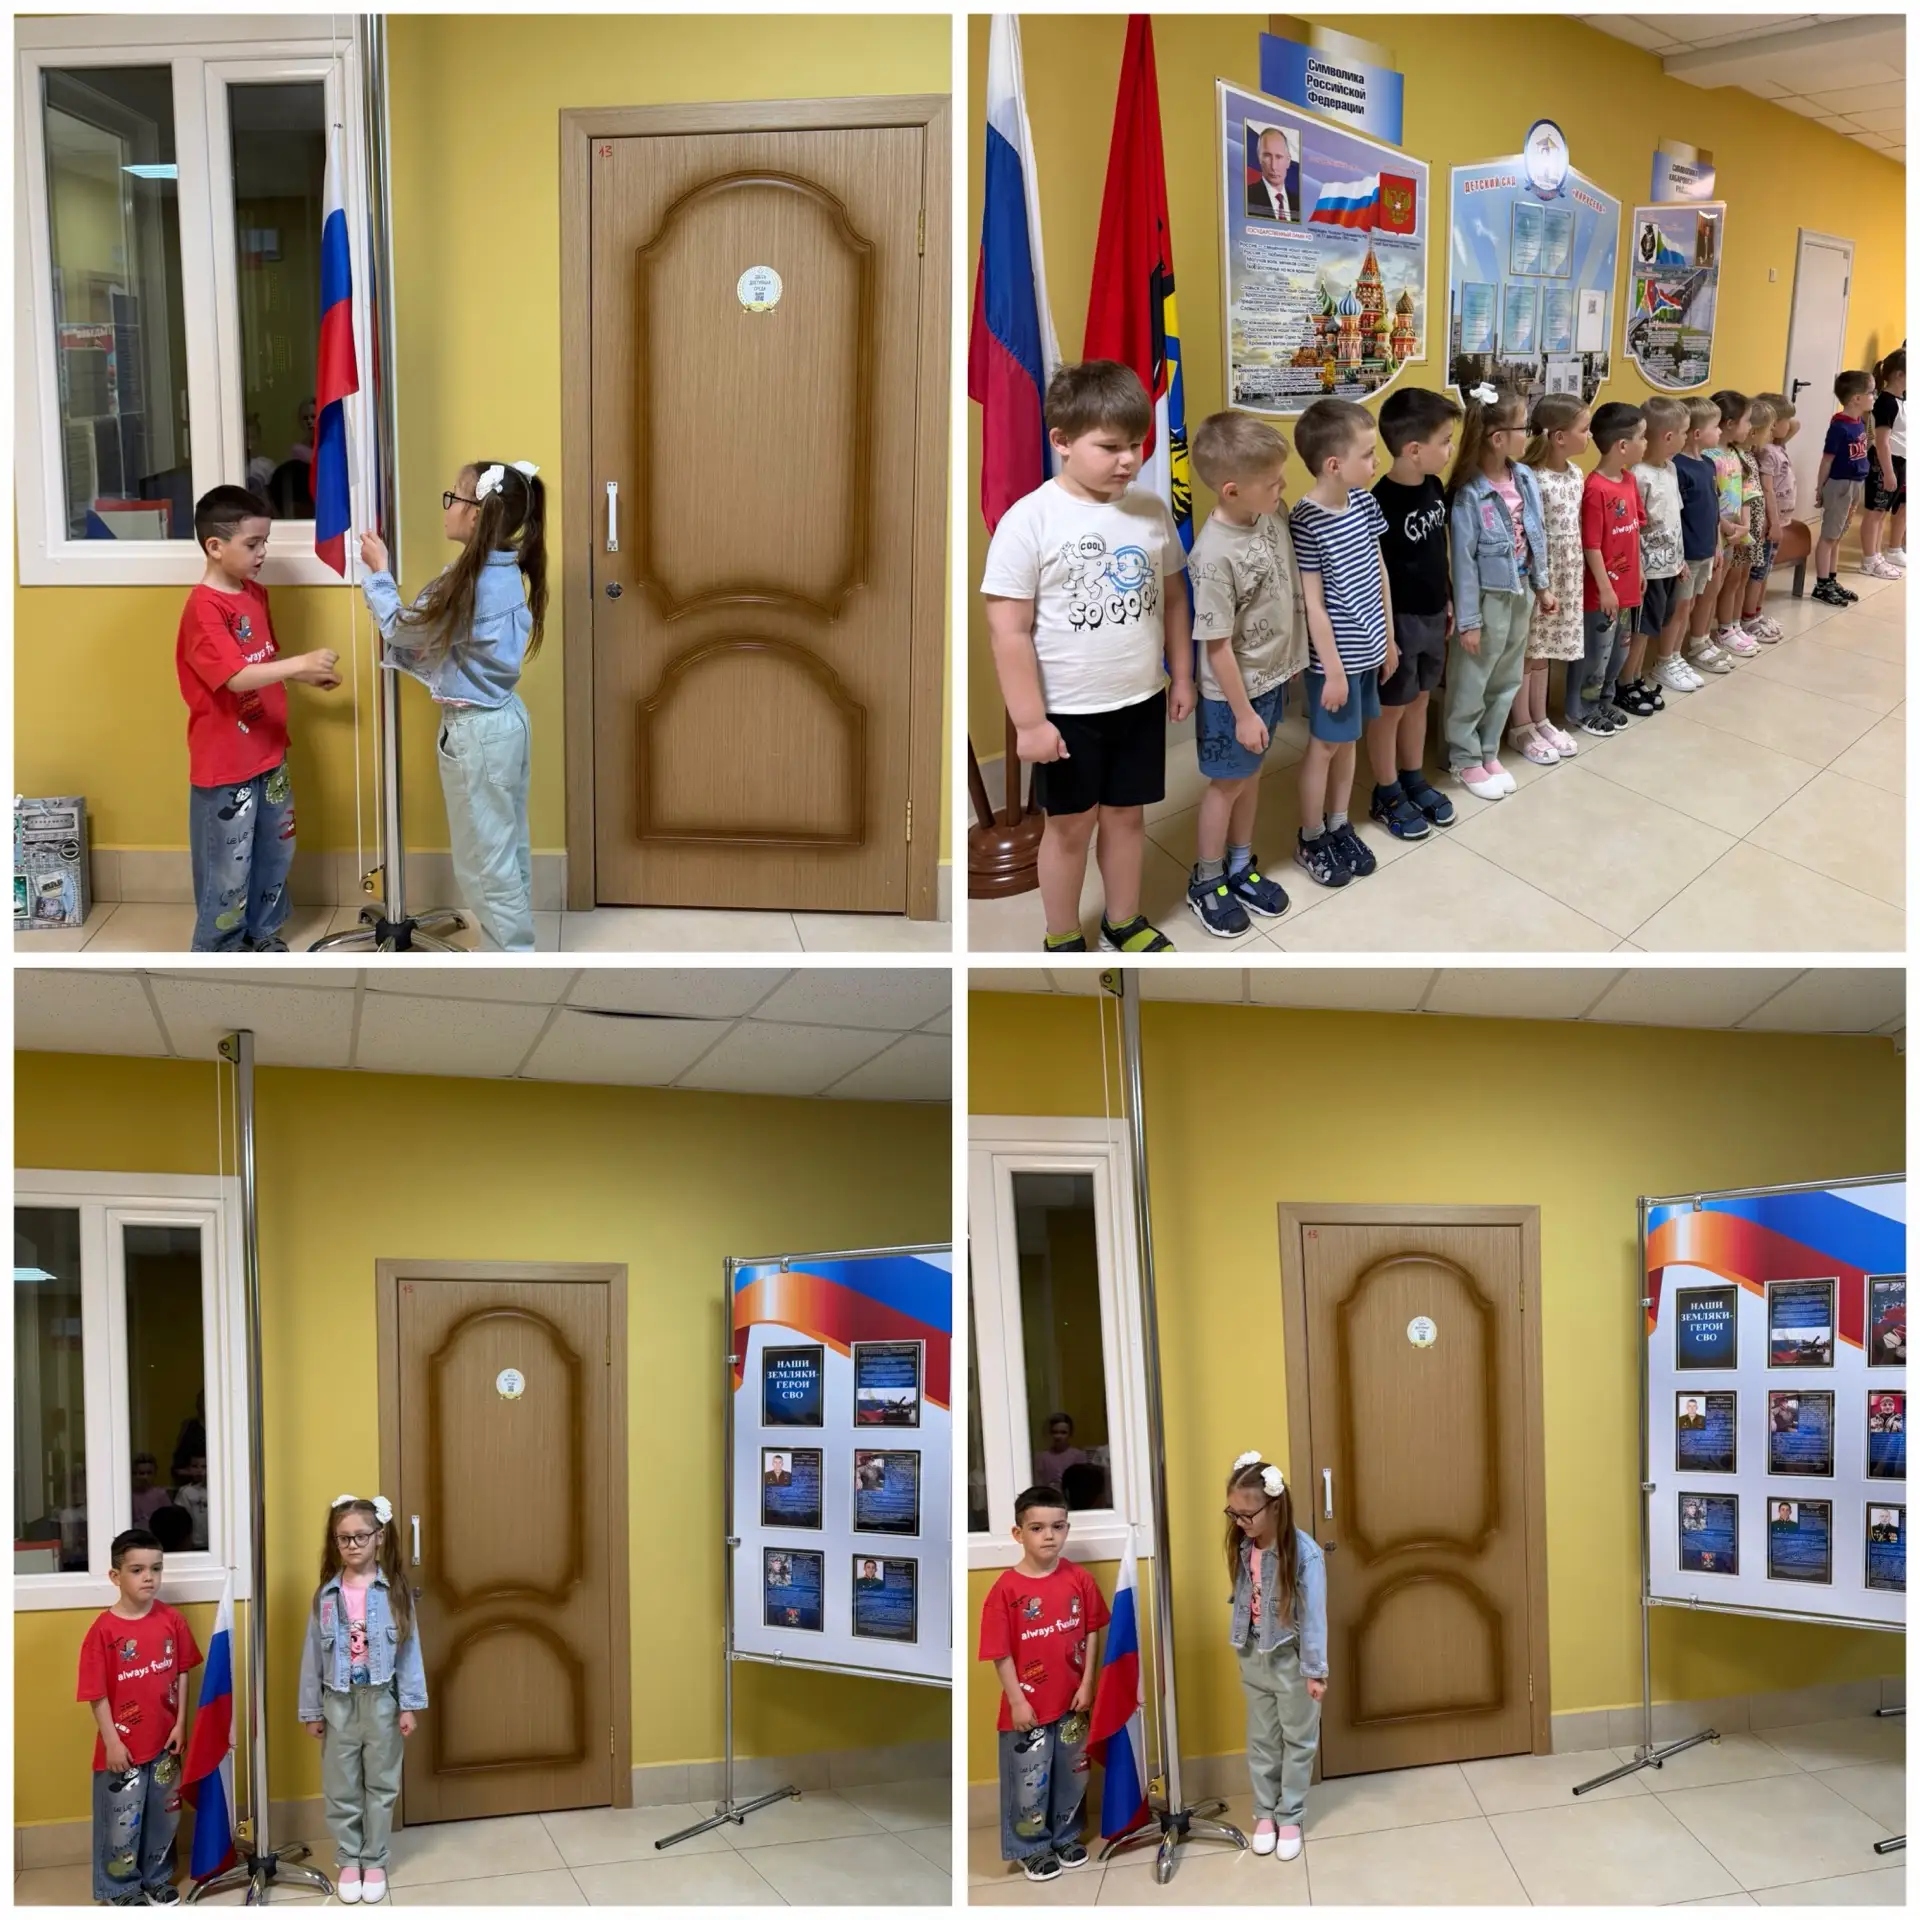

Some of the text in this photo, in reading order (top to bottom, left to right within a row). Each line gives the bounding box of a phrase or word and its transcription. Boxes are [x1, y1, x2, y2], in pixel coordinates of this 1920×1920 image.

[1308, 58, 1365, 85] Символика
[1306, 74, 1367, 100] Российской
[1308, 91, 1365, 115] Федерации
[1464, 175, 1517, 194] ДЕТСКИЙ САД
[1080, 541, 1103, 551] COOL
[1068, 602, 1103, 632] SO
[1690, 1301, 1724, 1311] НАШИ
[1680, 1311, 1734, 1322] ЗЕМЛЯКИ-
[1690, 1322, 1724, 1332] ГЕРОИ
[1695, 1333, 1718, 1342] СВО
[776, 1359, 810, 1369] НАШИ
[767, 1370, 820, 1379] ЗЕМЛЯКИ-
[776, 1380, 810, 1389] ГЕРОИ
[782, 1391, 804, 1400] СВО
[1021, 1625, 1055, 1641] always
[117, 1666, 150, 1682] always
